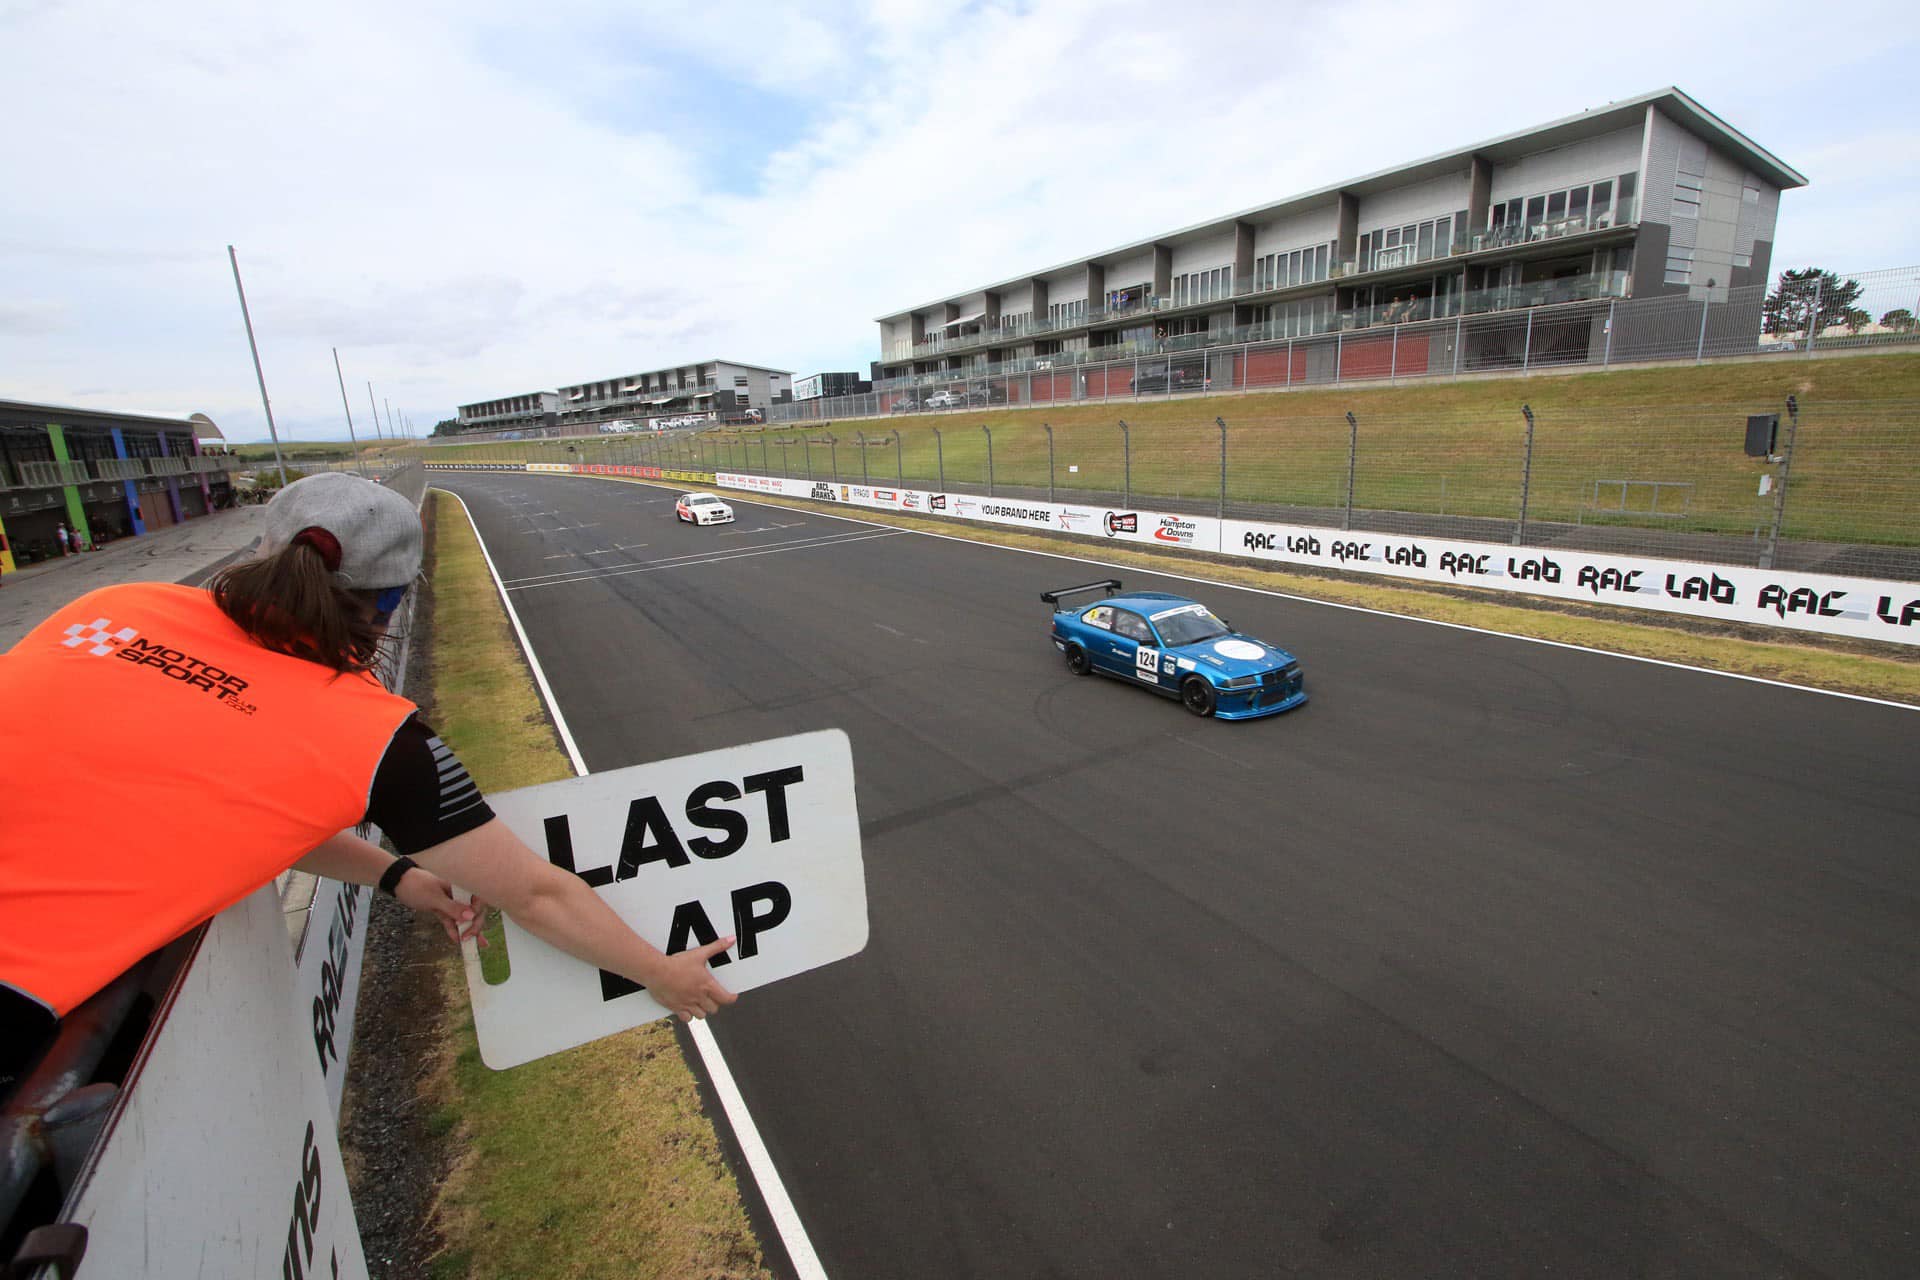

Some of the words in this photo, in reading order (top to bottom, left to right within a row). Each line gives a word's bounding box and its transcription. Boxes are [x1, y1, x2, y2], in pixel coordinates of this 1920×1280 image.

[981, 504, 1000, 516] YOUR
[1000, 506, 1028, 519] BRAND
[1028, 509, 1051, 522] HERE
[1160, 518, 1196, 530] Hampton
[1166, 527, 1194, 538] Downs
[130, 638, 249, 692] MOTOR
[1139, 651, 1156, 669] 124
[115, 648, 239, 700] SPORT
[543, 764, 804, 889] LAST
